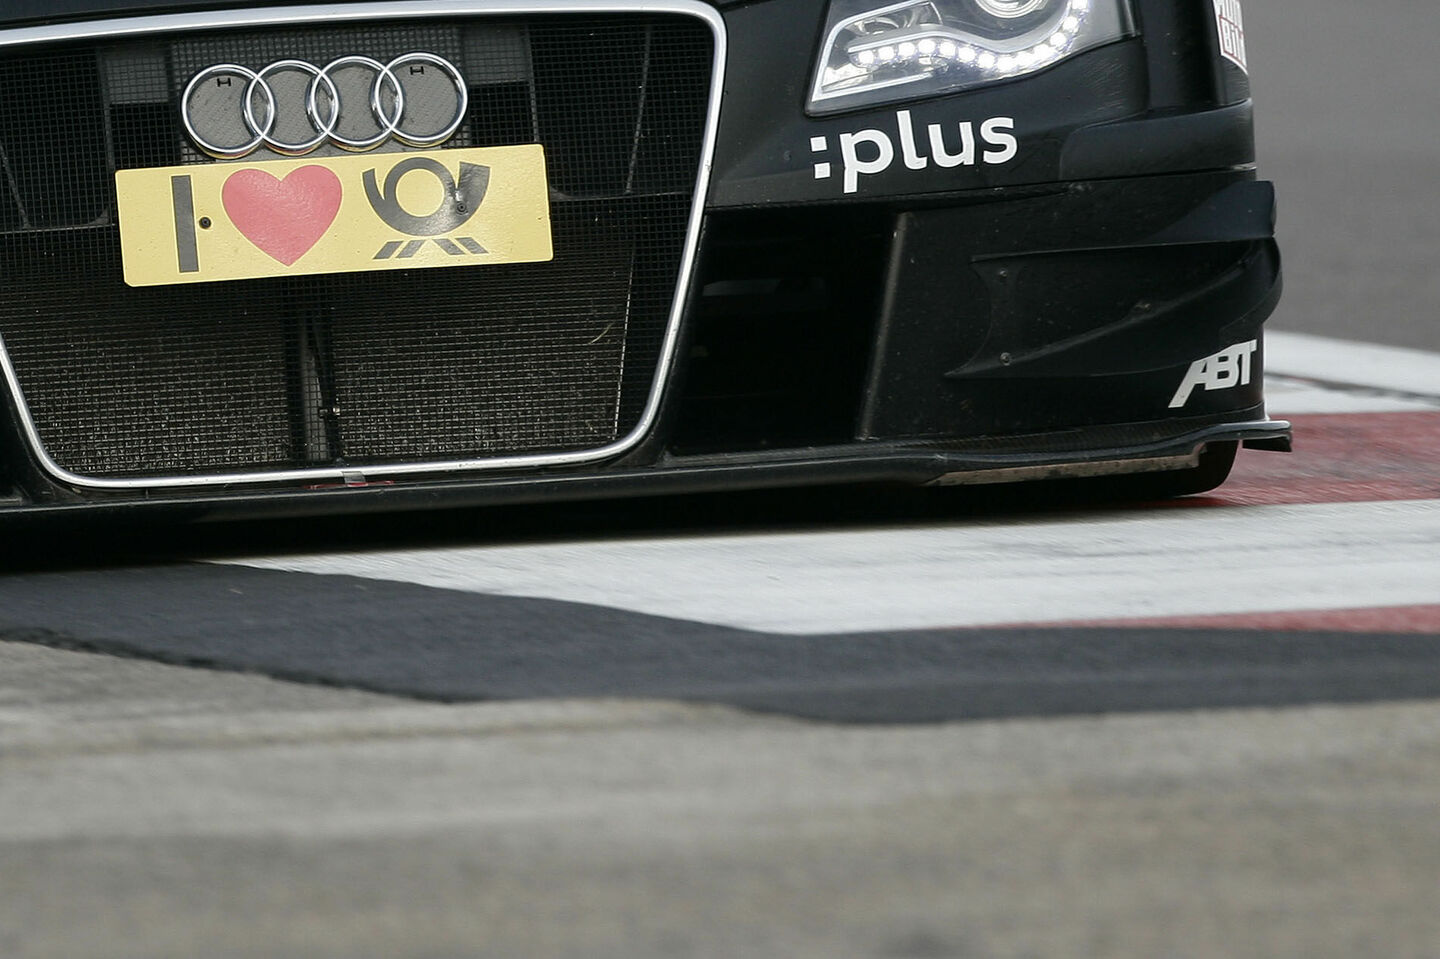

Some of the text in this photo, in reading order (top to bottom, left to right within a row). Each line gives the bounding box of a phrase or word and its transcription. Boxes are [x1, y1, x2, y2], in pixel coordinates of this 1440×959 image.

[810, 110, 1018, 193] :plus
[171, 174, 200, 273] I
[1168, 339, 1257, 409] ABT
